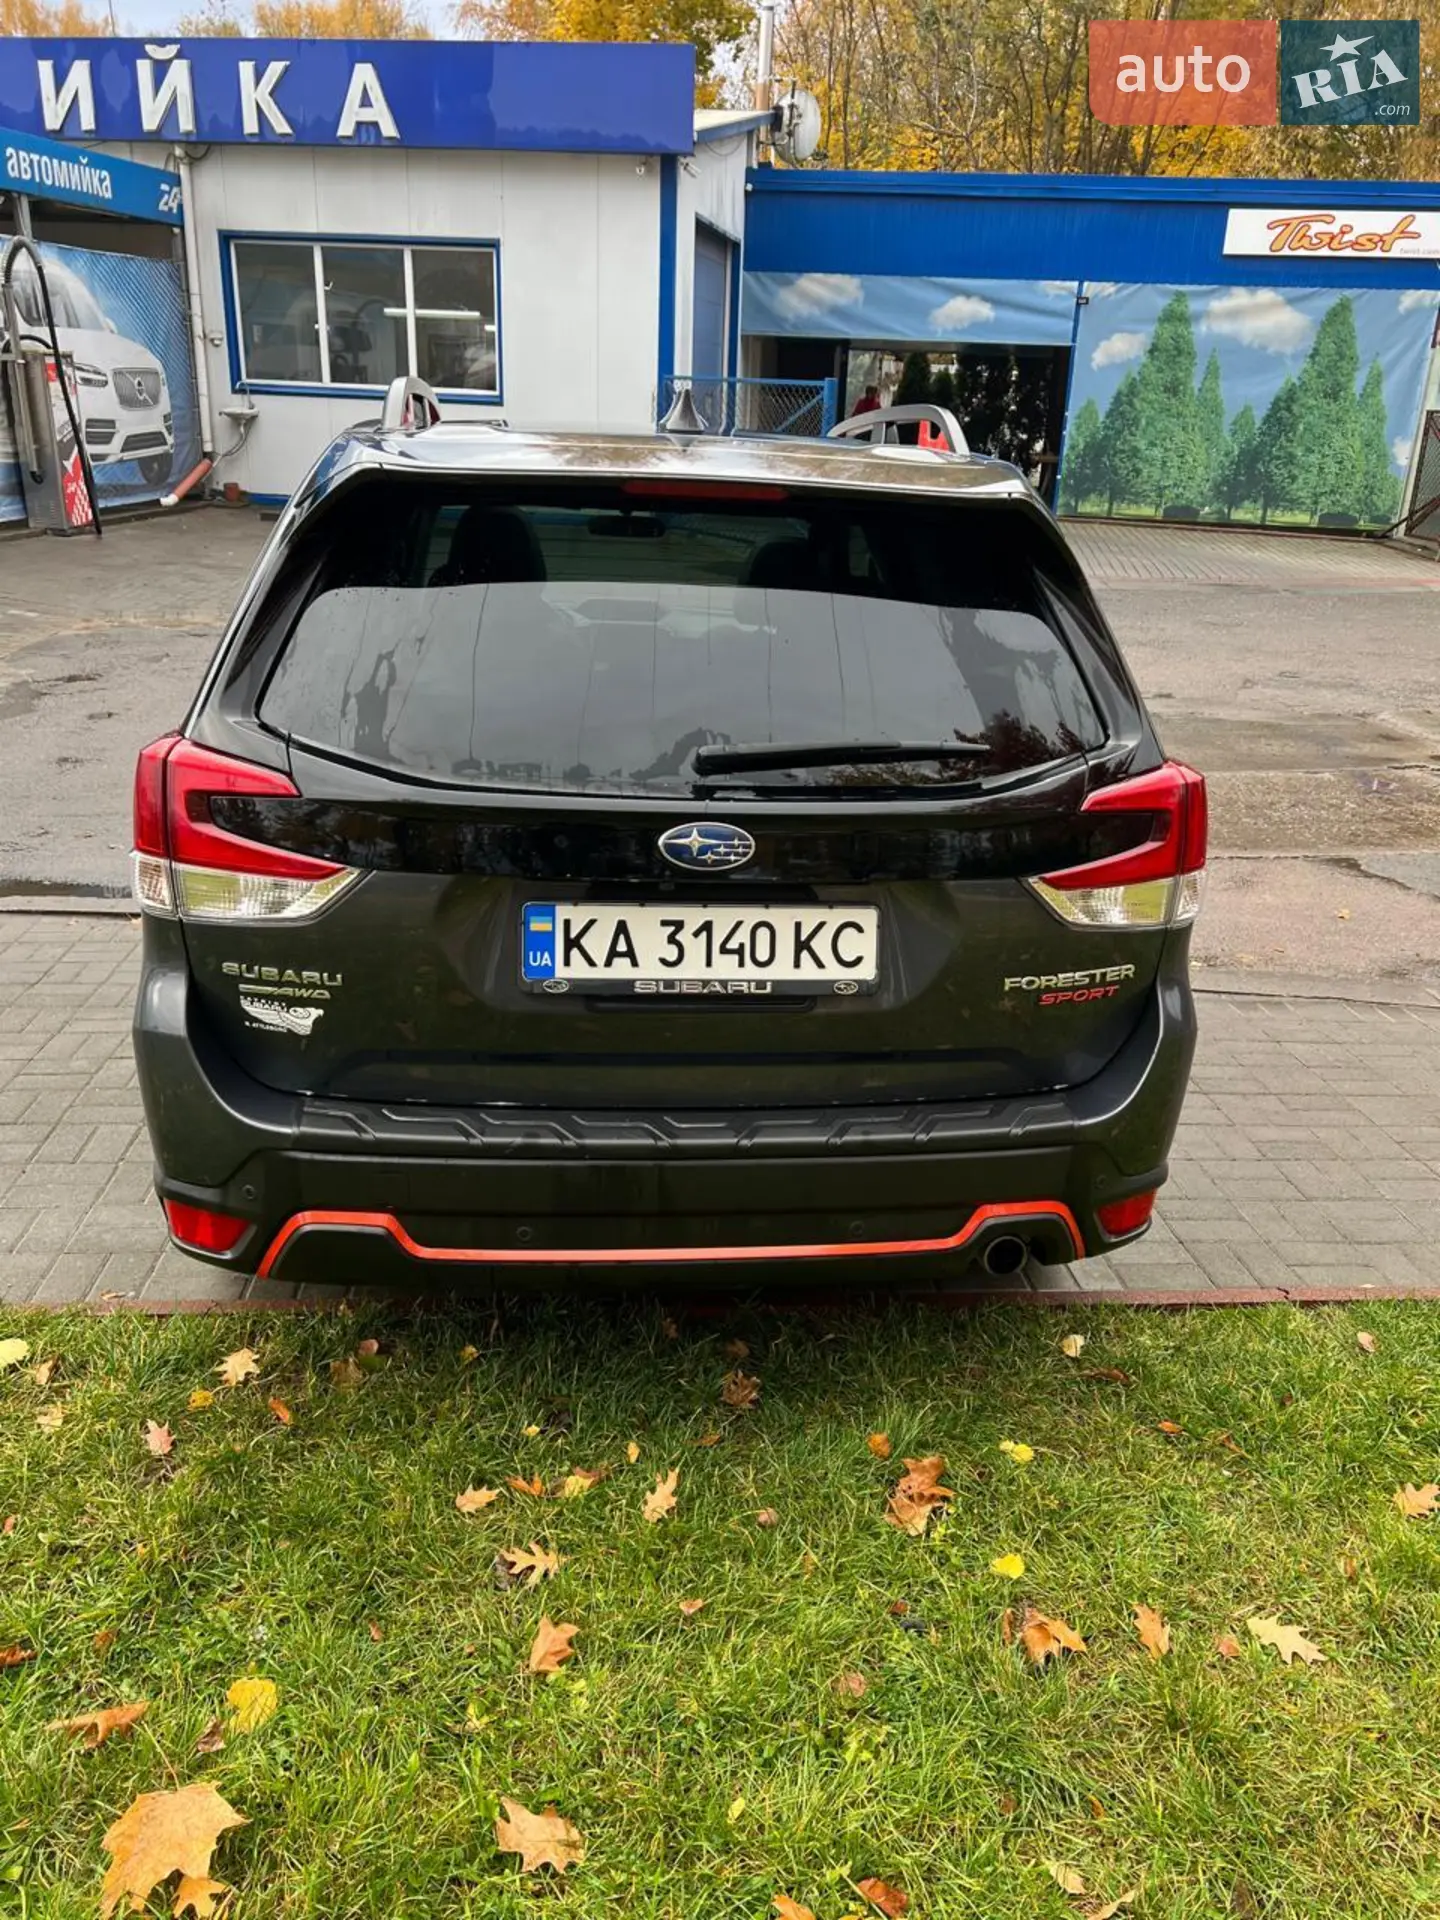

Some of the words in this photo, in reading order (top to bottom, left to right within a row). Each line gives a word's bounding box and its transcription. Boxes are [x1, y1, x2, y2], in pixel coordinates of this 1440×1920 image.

[5, 146, 113, 200] автомийка
[1267, 213, 1422, 253] Twist
[562, 918, 640, 969] KA
[658, 919, 777, 969] 3140
[792, 919, 866, 970] KC
[528, 951, 552, 967] UA
[221, 961, 343, 987] SUBARU
[1003, 963, 1136, 992] FORESTER
[273, 986, 332, 1000] AWD
[633, 980, 773, 995] SUBARU
[1038, 984, 1120, 1005] SPORT
